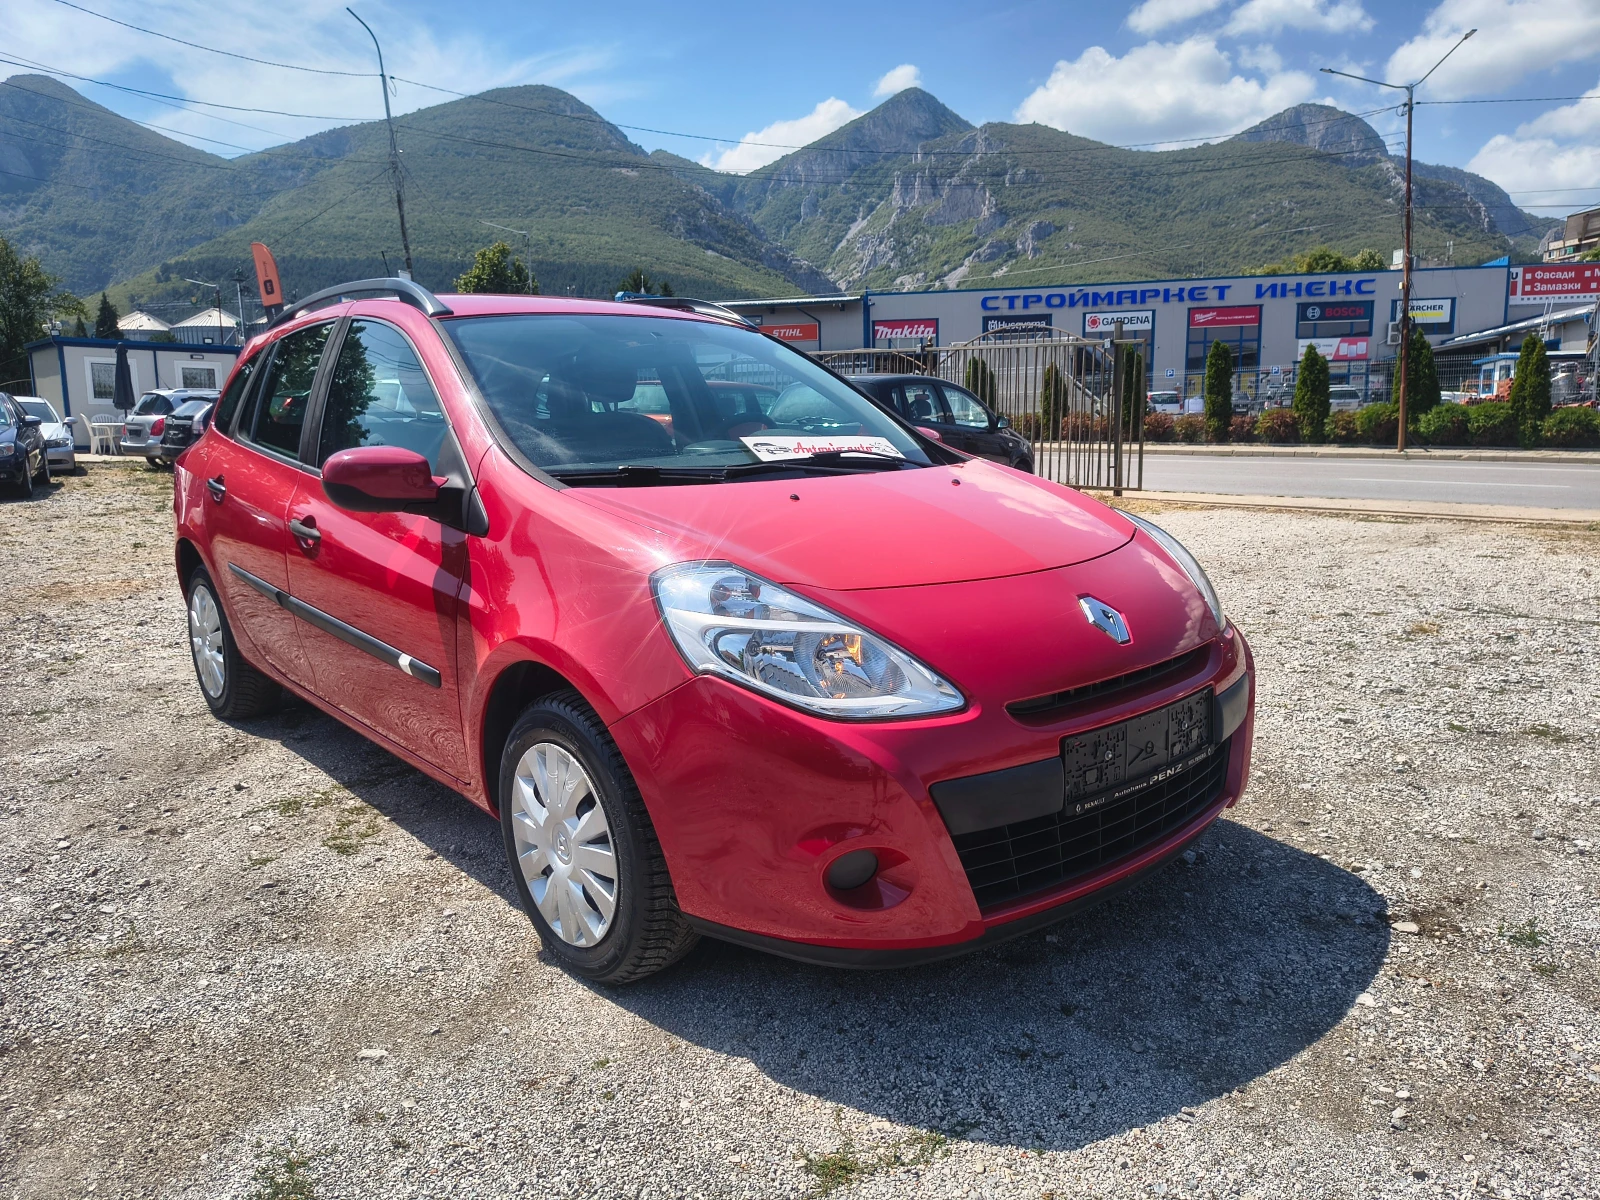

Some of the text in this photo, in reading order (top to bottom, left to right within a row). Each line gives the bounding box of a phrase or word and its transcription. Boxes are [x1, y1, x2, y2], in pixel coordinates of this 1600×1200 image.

[1534, 270, 1575, 280] Фасади
[1533, 282, 1581, 291] Замазки
[981, 279, 1376, 310] СТРОЙМАРКЕТ ИНЕКС
[1325, 307, 1365, 317] BOSCH
[998, 320, 1046, 330] Husqvarna
[1102, 316, 1150, 326] GARDENA
[773, 328, 803, 337] STIHL
[1084, 763, 1183, 810] RENAULT Autohaus PENZ
